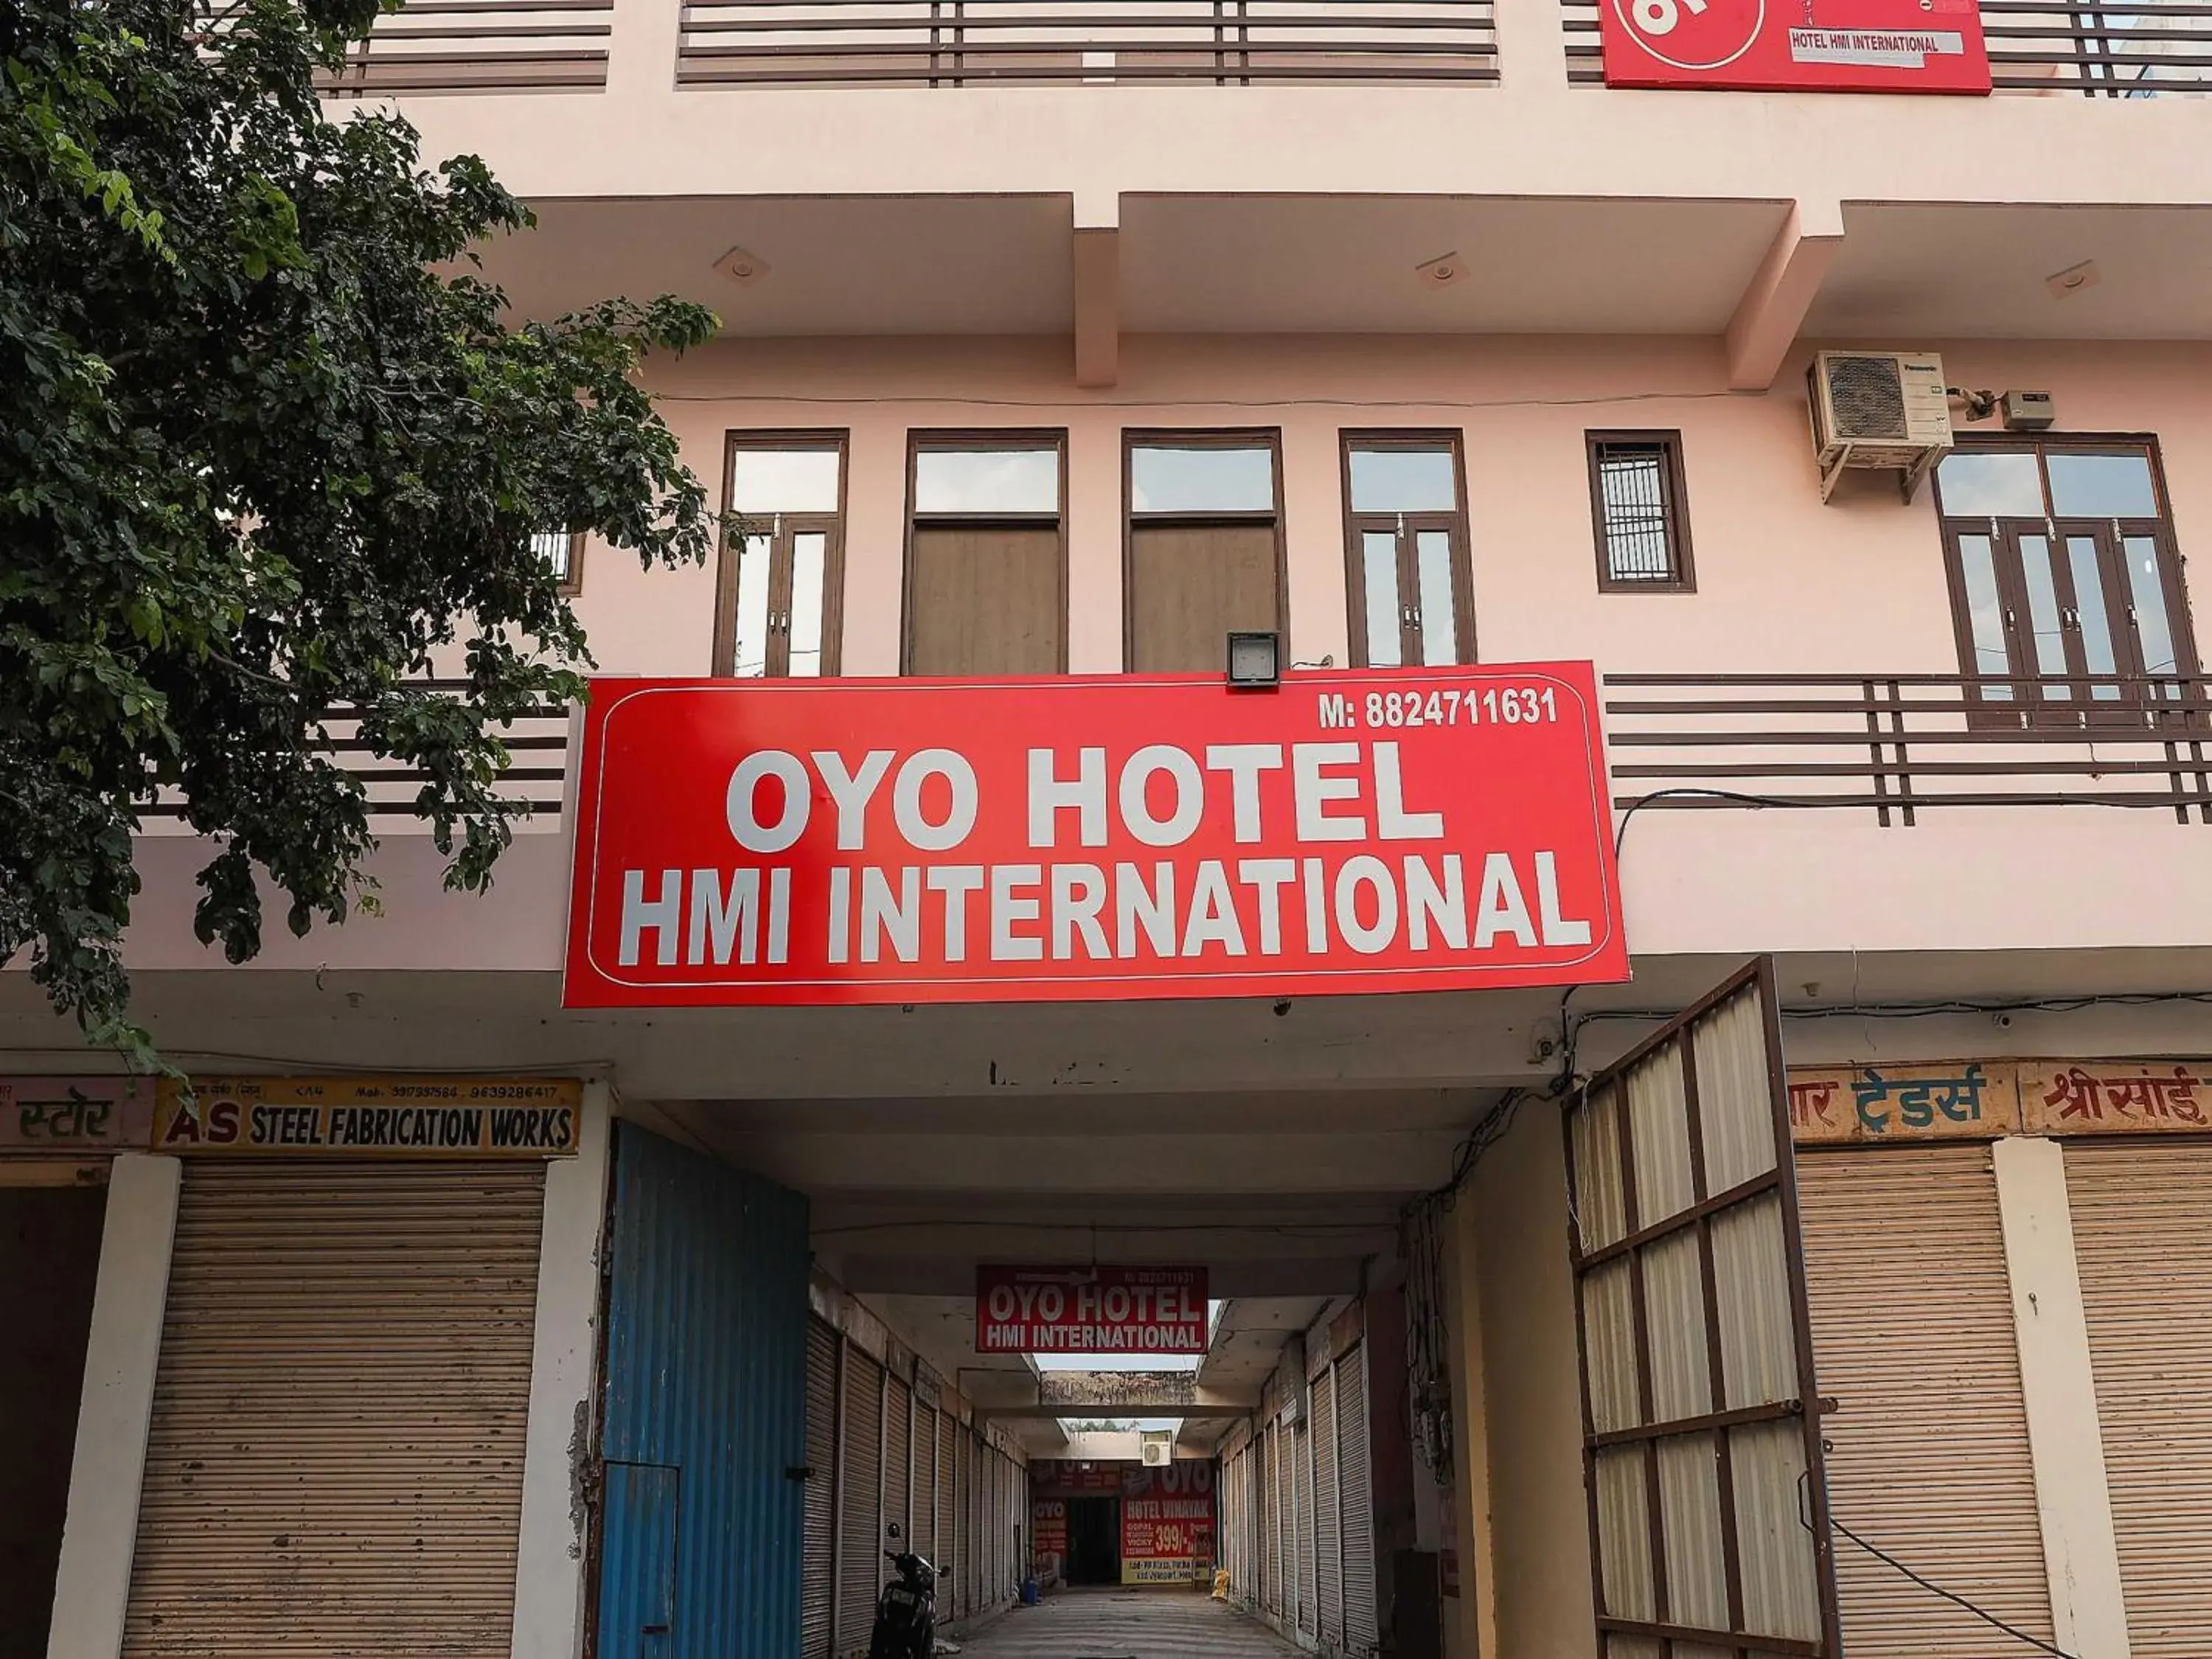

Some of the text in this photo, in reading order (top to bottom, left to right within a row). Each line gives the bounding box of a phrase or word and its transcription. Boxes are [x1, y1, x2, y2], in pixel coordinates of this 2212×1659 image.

[1792, 32, 1938, 52] HOTEL HMI INTERNATIONAL
[1318, 686, 1557, 728] M: 8824711631
[726, 740, 1445, 854] OYO HOTEL
[617, 851, 1593, 967] HMI INTERNATIONAL
[251, 1105, 321, 1144] STEEL
[330, 1107, 483, 1147] FABRICATION
[490, 1107, 572, 1148] WORKS
[989, 1285, 1201, 1322] OYO HOTEL
[987, 1324, 1201, 1349] HMI INTERNATIONAL
[1127, 1500, 1161, 1519] HOTEL
